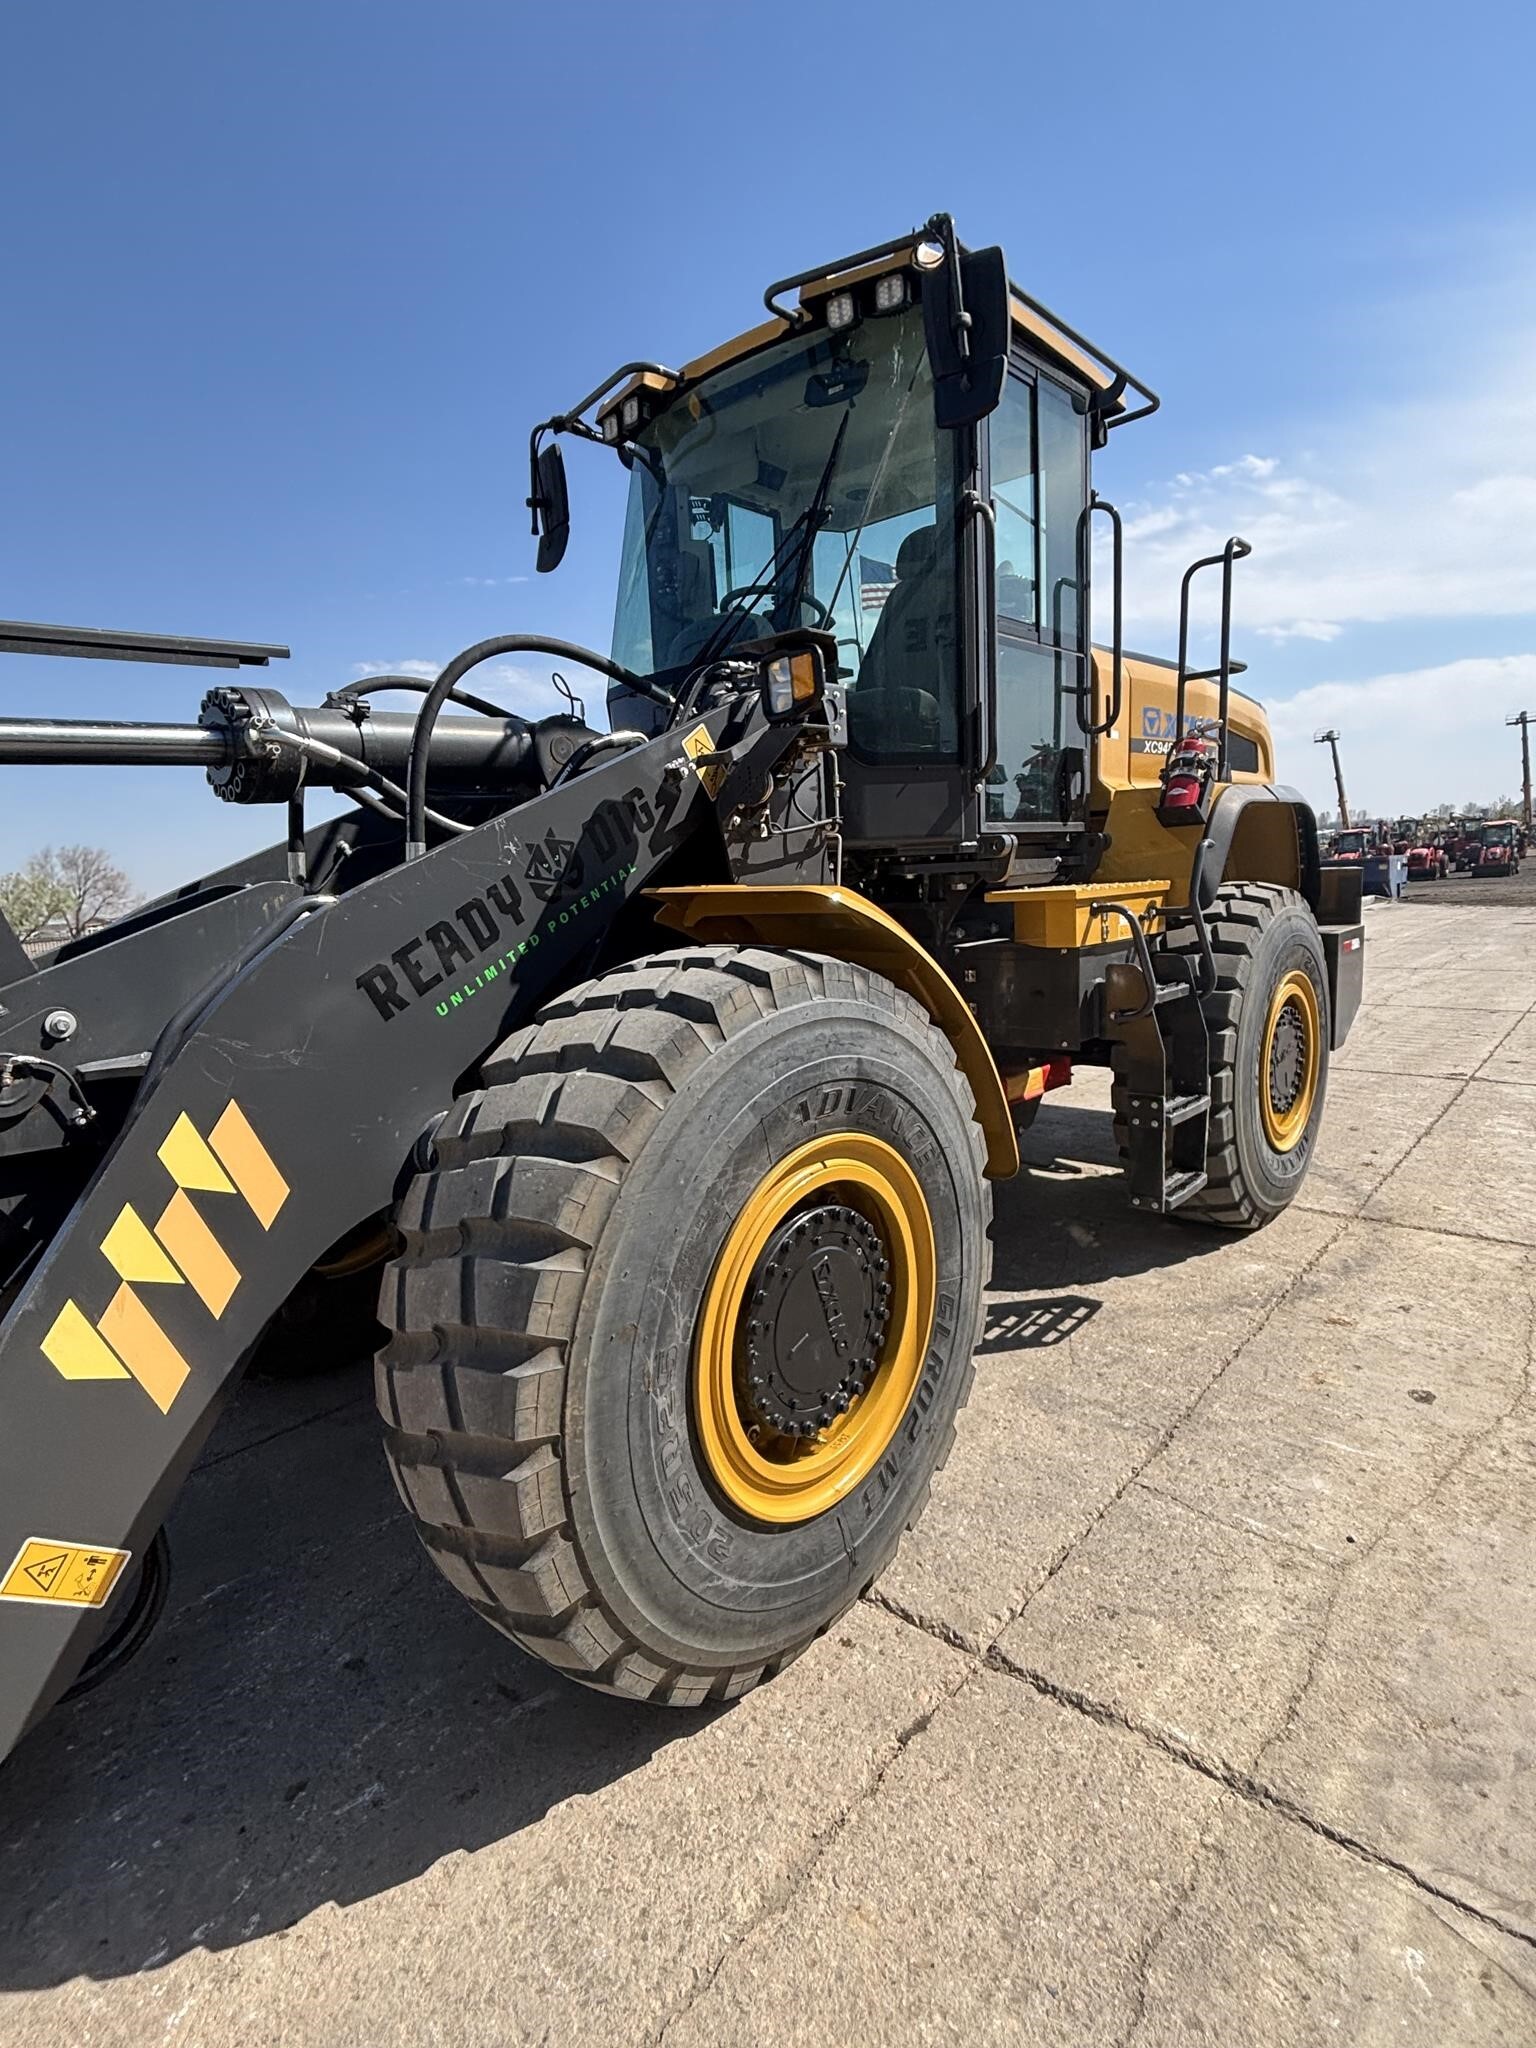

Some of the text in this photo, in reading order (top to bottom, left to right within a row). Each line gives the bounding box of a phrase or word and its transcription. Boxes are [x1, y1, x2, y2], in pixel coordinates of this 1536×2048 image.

[355, 874, 525, 1022] READY
[435, 862, 638, 1017] UNLIMITED POTENTIAL
[793, 1086, 938, 1168] ADVANCE
